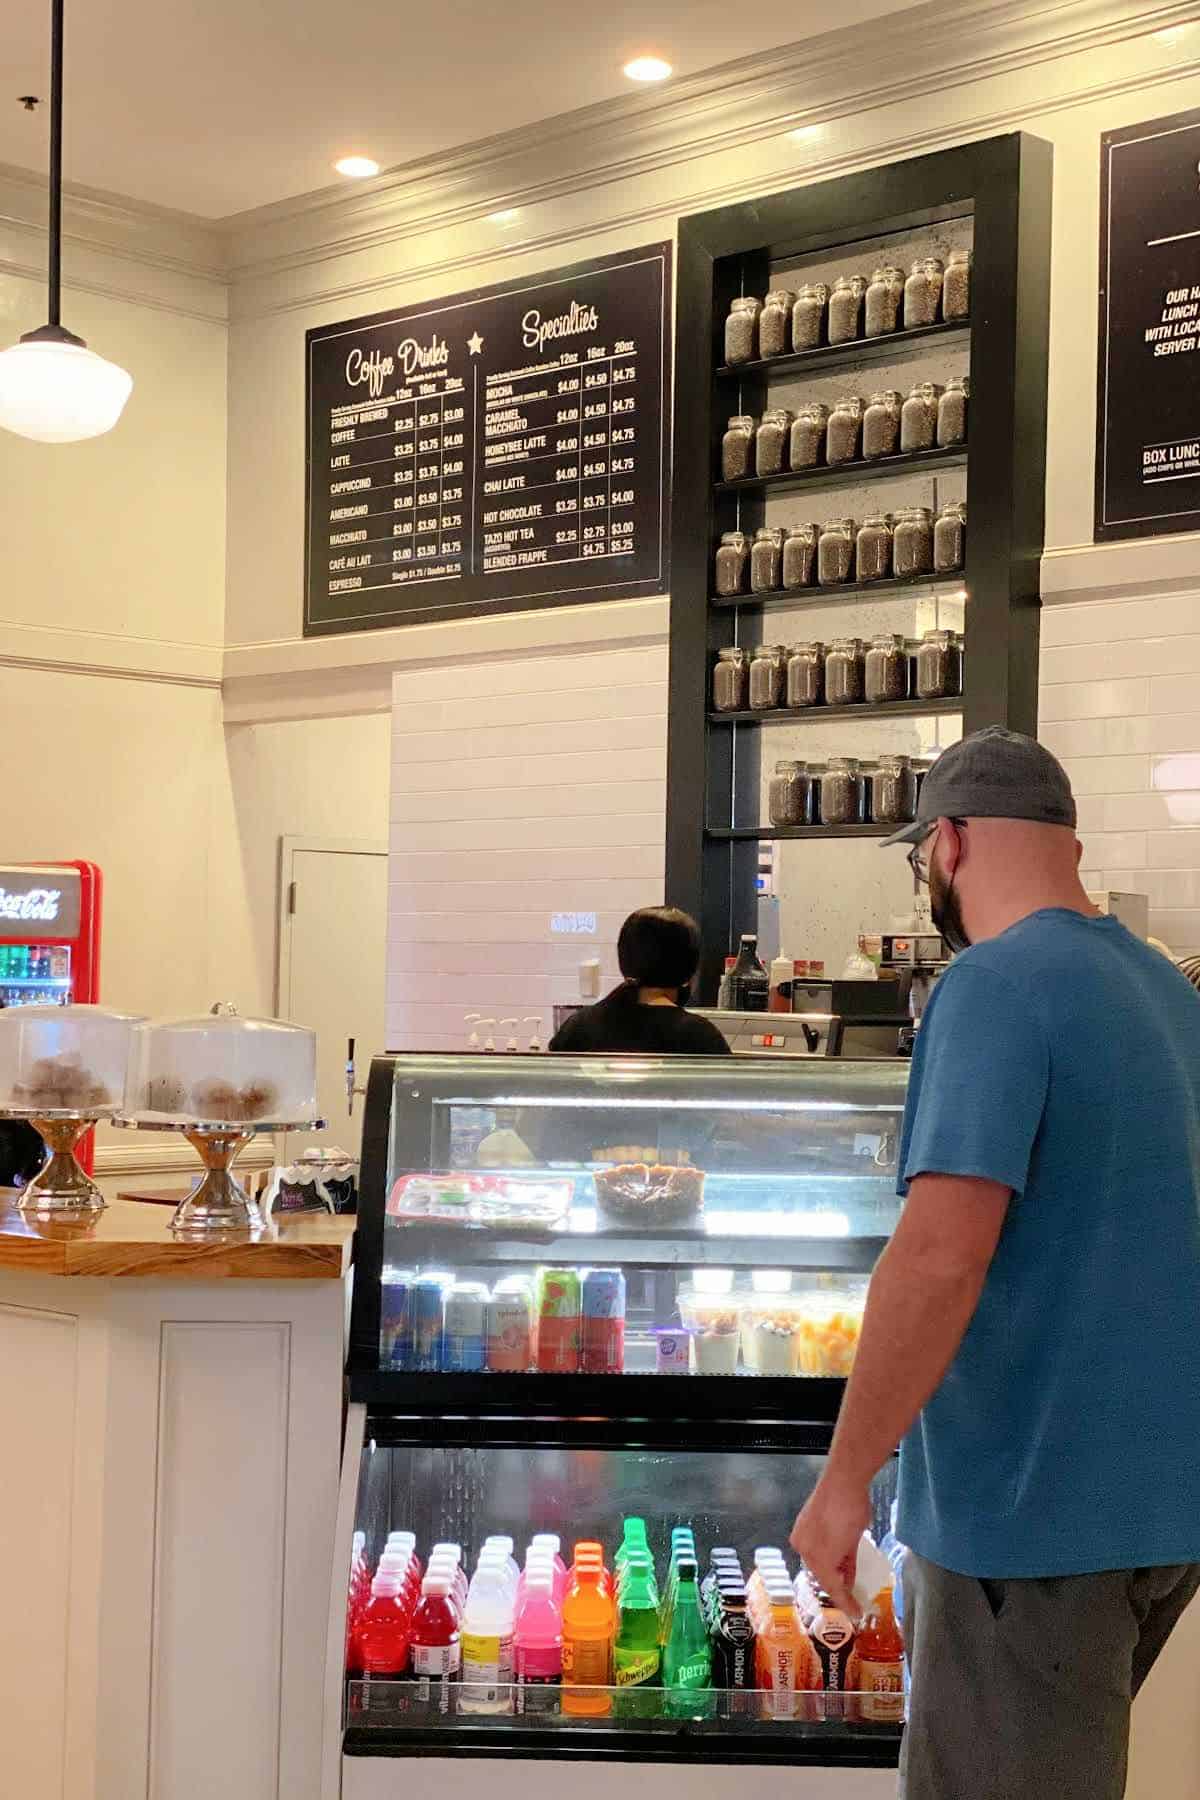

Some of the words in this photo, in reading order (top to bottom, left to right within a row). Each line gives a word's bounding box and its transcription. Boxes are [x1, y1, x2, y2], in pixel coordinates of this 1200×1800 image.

[1166, 288, 1190, 305] OUR
[522, 300, 599, 353] Specialties
[1161, 303, 1199, 322] LUNCH
[1144, 325, 1173, 343] WITH
[1153, 337, 1196, 357] SERVER
[346, 349, 394, 397] Coffee
[398, 334, 449, 375] Drinks
[559, 353, 579, 365] 12oz
[587, 347, 606, 360] 16oz
[614, 341, 635, 353] 20oz
[396, 388, 413, 400] 12oz
[420, 383, 436, 395] 16oz
[445, 378, 463, 389] 20oz
[486, 385, 513, 400] MOCHA
[557, 379, 579, 394] $4.00
[585, 373, 607, 388] $4.50
[613, 367, 635, 382] $4.75
[331, 414, 358, 429] FRESHLY
[359, 408, 389, 423] BREWED
[331, 429, 356, 444] COFFEE
[395, 418, 414, 433] $2.25
[419, 413, 439, 427] $2.75
[444, 408, 464, 422] $3.00
[485, 408, 520, 426] CARAMEL
[485, 418, 528, 437] MACCHIATO
[556, 408, 579, 424] $4.00
[584, 403, 607, 418] $4.50
[612, 398, 635, 413] $4.75
[331, 455, 351, 469] LATTE
[394, 443, 414, 457] $3.25
[419, 438, 439, 452] $3.75
[443, 434, 464, 448] $4.00
[485, 439, 523, 457] HONEYBEE
[523, 435, 547, 449] LATTE
[556, 438, 578, 453] $4.00
[583, 432, 606, 447] $4.50
[612, 428, 635, 443] $4.75
[1143, 448, 1167, 465] BOX
[330, 477, 371, 494] CAPPUCCINO
[394, 470, 414, 484] $3.25
[418, 465, 439, 480] $3.75
[443, 461, 463, 475] $4.00
[483, 480, 502, 494] CHAI
[503, 475, 526, 490] LATTE
[556, 467, 578, 482] $4.00
[583, 462, 606, 477] $4.50
[611, 457, 634, 472] $4.75
[329, 504, 368, 521] AMERICANO
[394, 496, 413, 510] $3.00
[418, 492, 438, 506] $3.50
[442, 487, 462, 501] $3.75
[483, 511, 498, 524] HOT
[499, 504, 543, 522] CHOCOLATE
[555, 499, 577, 513] $3.25
[583, 494, 605, 509] $3.75
[611, 490, 634, 505] $4.00
[329, 530, 368, 546] MACCHIATO
[393, 522, 413, 537] $3.00
[417, 518, 437, 533] $3.50
[442, 514, 462, 529] $3.75
[484, 532, 503, 545] TAZO
[503, 530, 519, 542] HOT
[519, 527, 535, 540] TEA
[555, 530, 577, 544] $2.25
[583, 526, 605, 540] $2.75
[611, 521, 634, 536] $3.00
[347, 556, 356, 568] AU
[357, 554, 372, 566] LAIT
[392, 548, 412, 562] $3.00
[417, 544, 436, 559] $3.50
[441, 540, 461, 555] $3.75
[483, 554, 517, 570] BLENDED
[518, 550, 548, 565] FRAPPE
[582, 542, 605, 557] $4.75
[611, 538, 634, 553] $5.25
[329, 576, 362, 592] ESPRESSO
